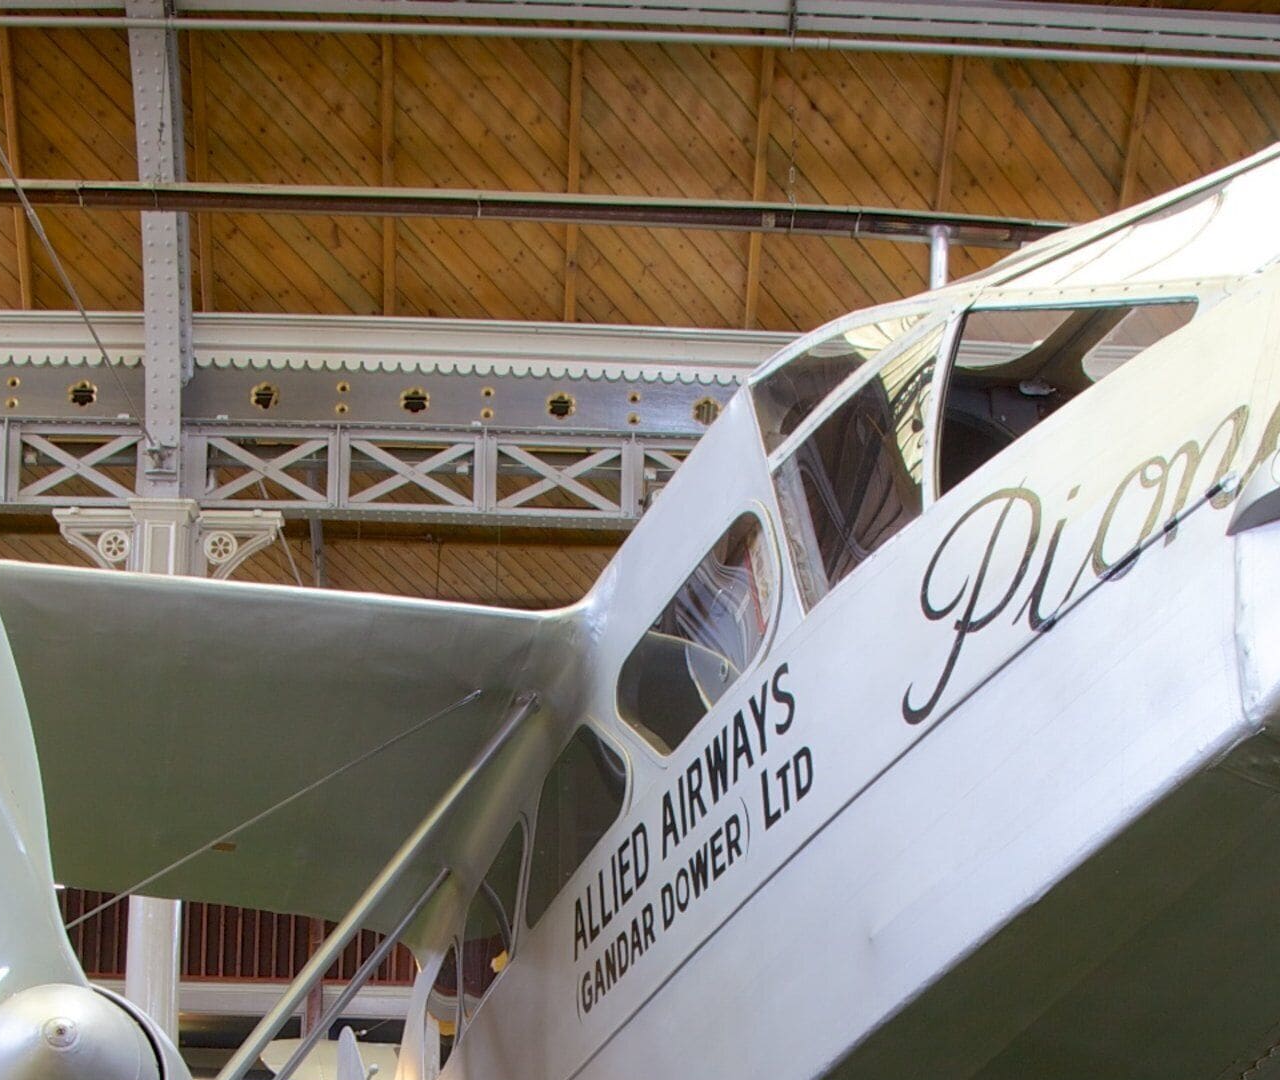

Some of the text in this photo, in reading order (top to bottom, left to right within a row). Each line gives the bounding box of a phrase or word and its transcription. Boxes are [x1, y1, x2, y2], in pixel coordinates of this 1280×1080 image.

[574, 662, 795, 962] ALLIED AIRWAYS
[576, 746, 814, 1024] (GANDAR DOWER) LTD
